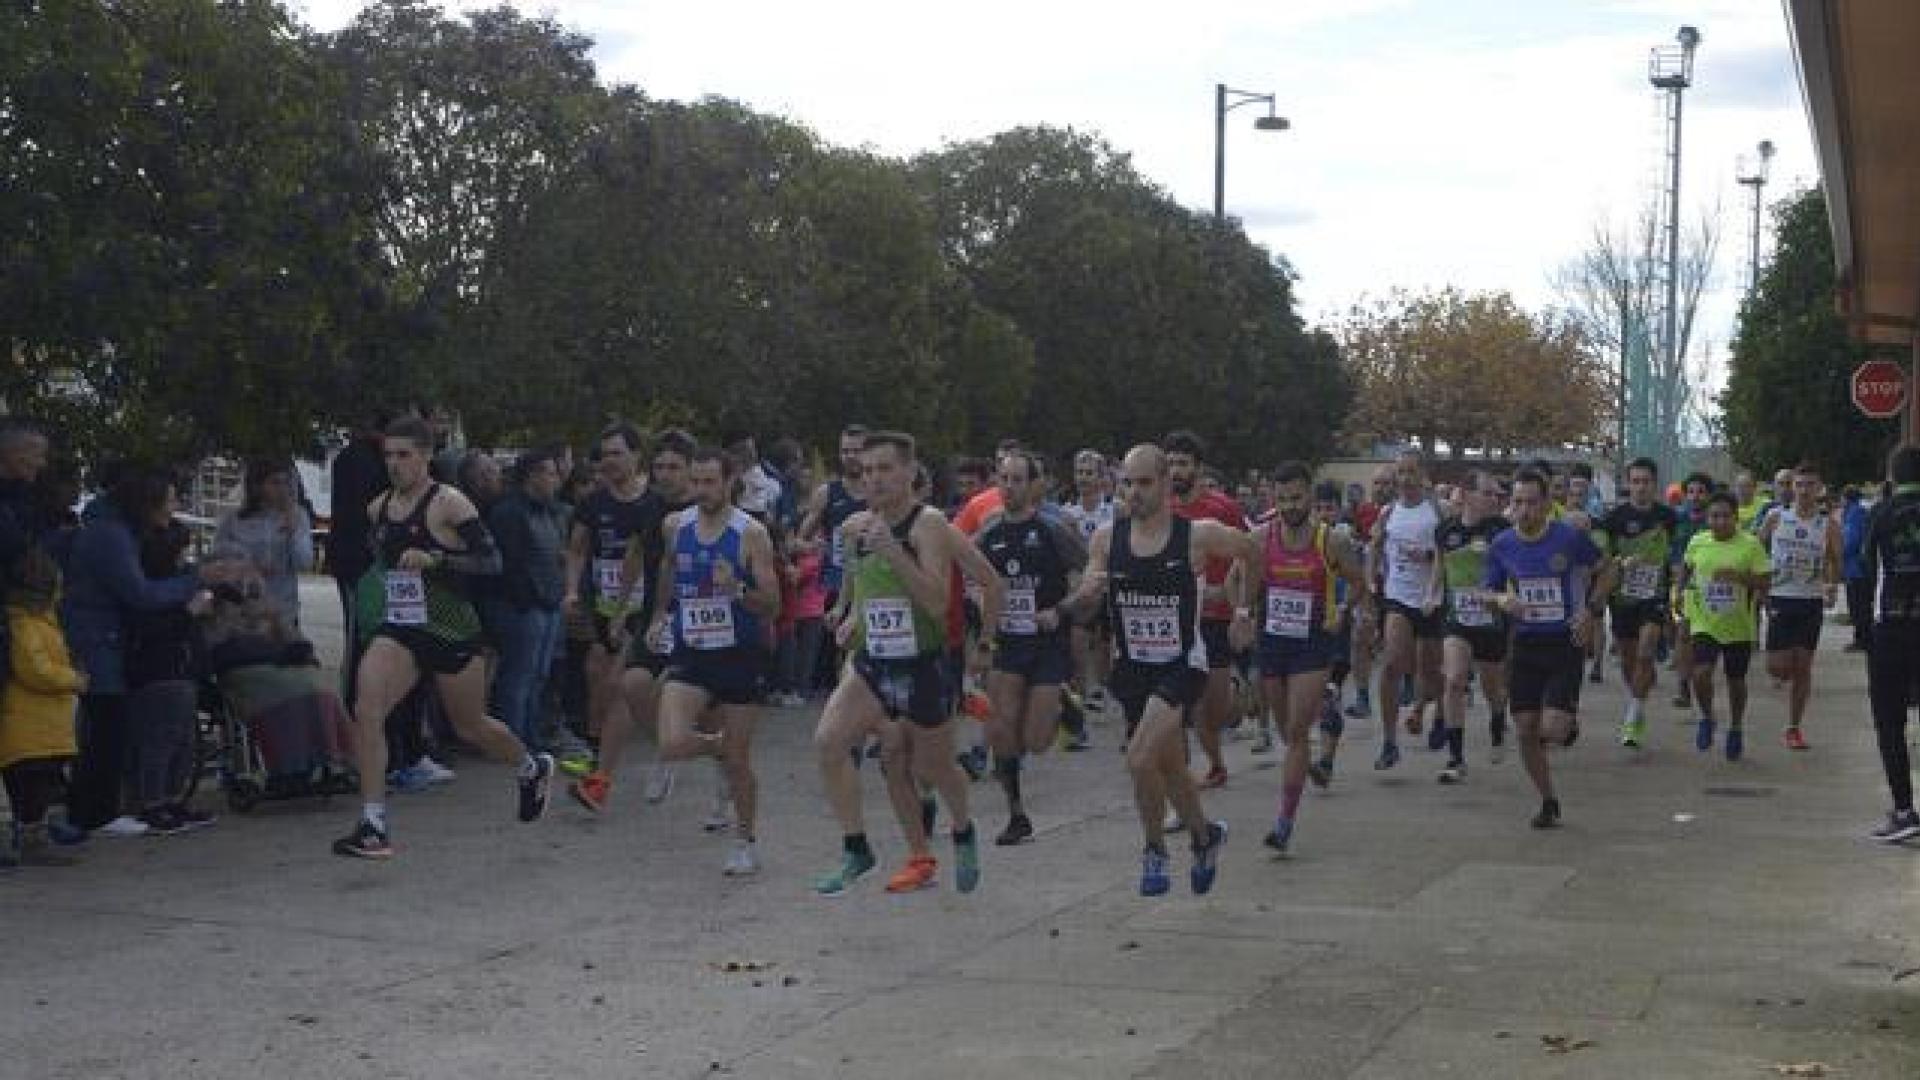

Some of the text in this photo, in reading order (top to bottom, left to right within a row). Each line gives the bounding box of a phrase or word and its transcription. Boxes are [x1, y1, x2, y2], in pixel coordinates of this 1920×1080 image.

[1858, 381, 1903, 397] STOP
[867, 610, 903, 630] 157
[1129, 619, 1172, 637] 212
